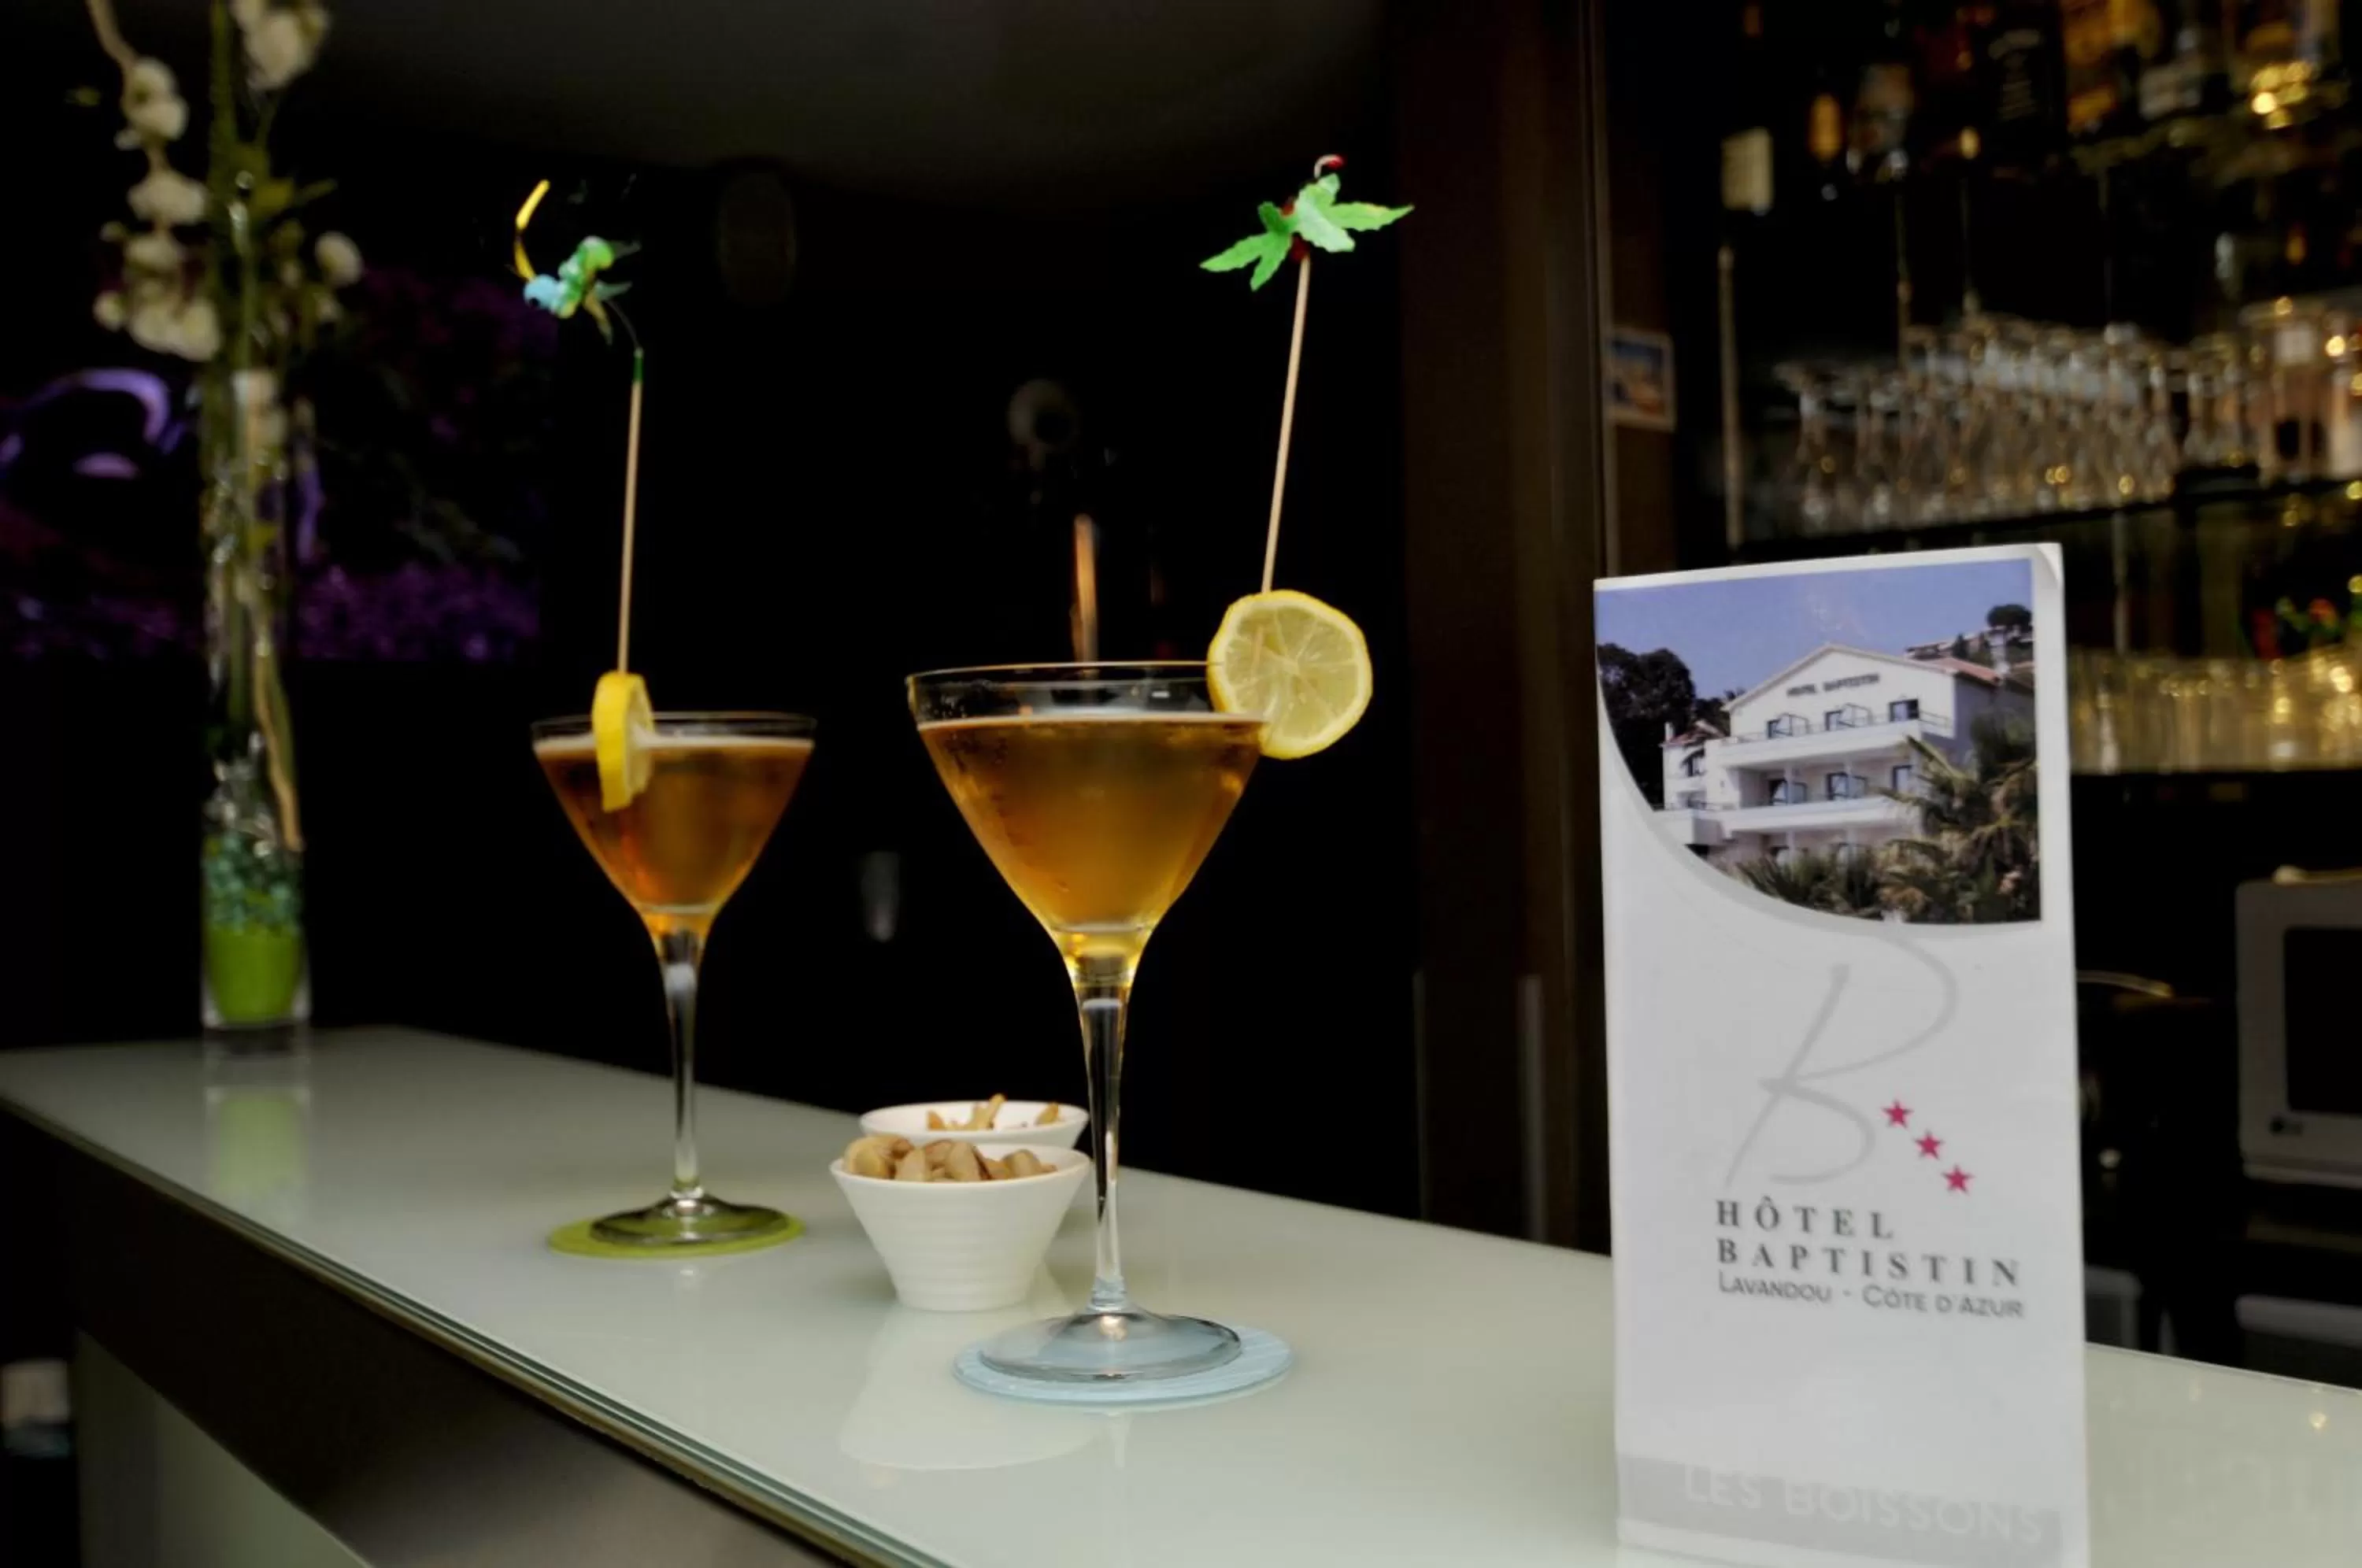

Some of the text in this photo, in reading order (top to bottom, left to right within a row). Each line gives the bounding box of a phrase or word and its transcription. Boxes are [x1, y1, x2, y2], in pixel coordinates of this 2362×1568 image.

[1716, 1196, 1894, 1239] HÔTEL
[1716, 1238, 2019, 1287] BAPTISTIN
[1685, 1465, 2042, 1544] LES BOISSONS
